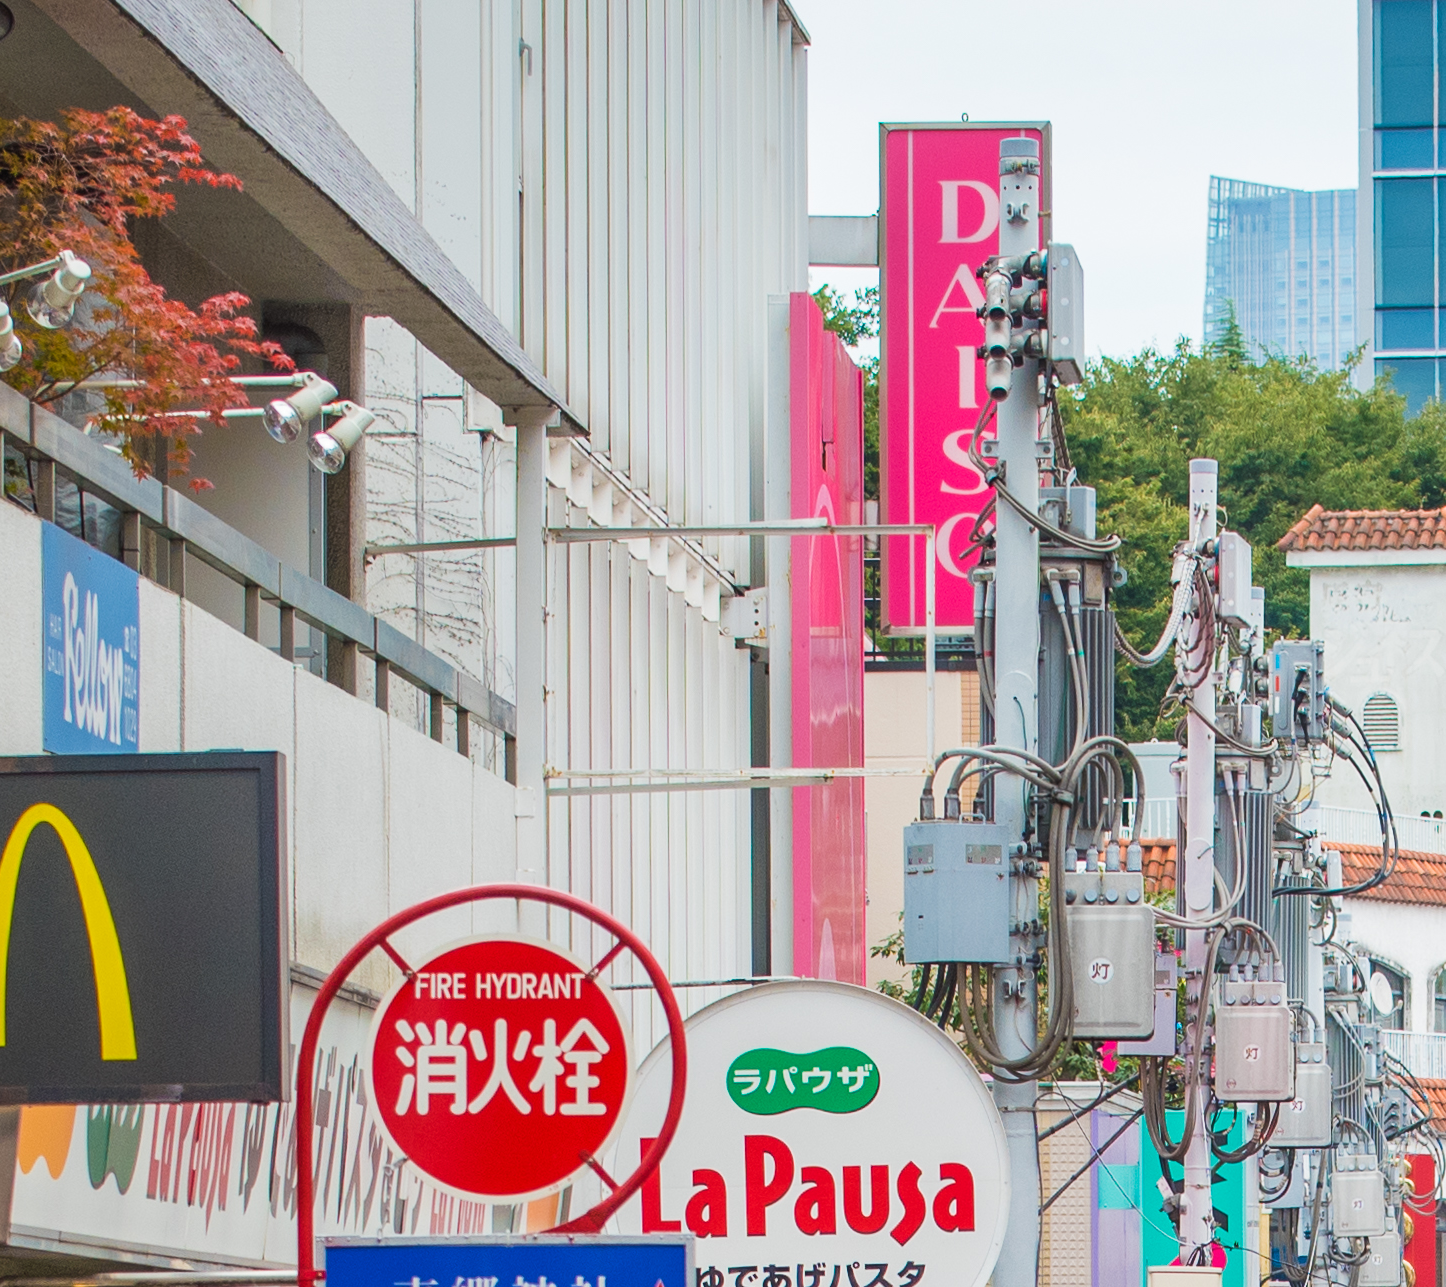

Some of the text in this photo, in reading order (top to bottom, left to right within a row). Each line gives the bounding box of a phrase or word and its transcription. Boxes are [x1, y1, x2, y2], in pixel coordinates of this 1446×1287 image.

[415, 972, 584, 1001] FIRE HYDRANT
[394, 1017, 608, 1116] 消火栓
[731, 1065, 874, 1096] ラパウザ
[744, 1135, 975, 1247] Pausa
